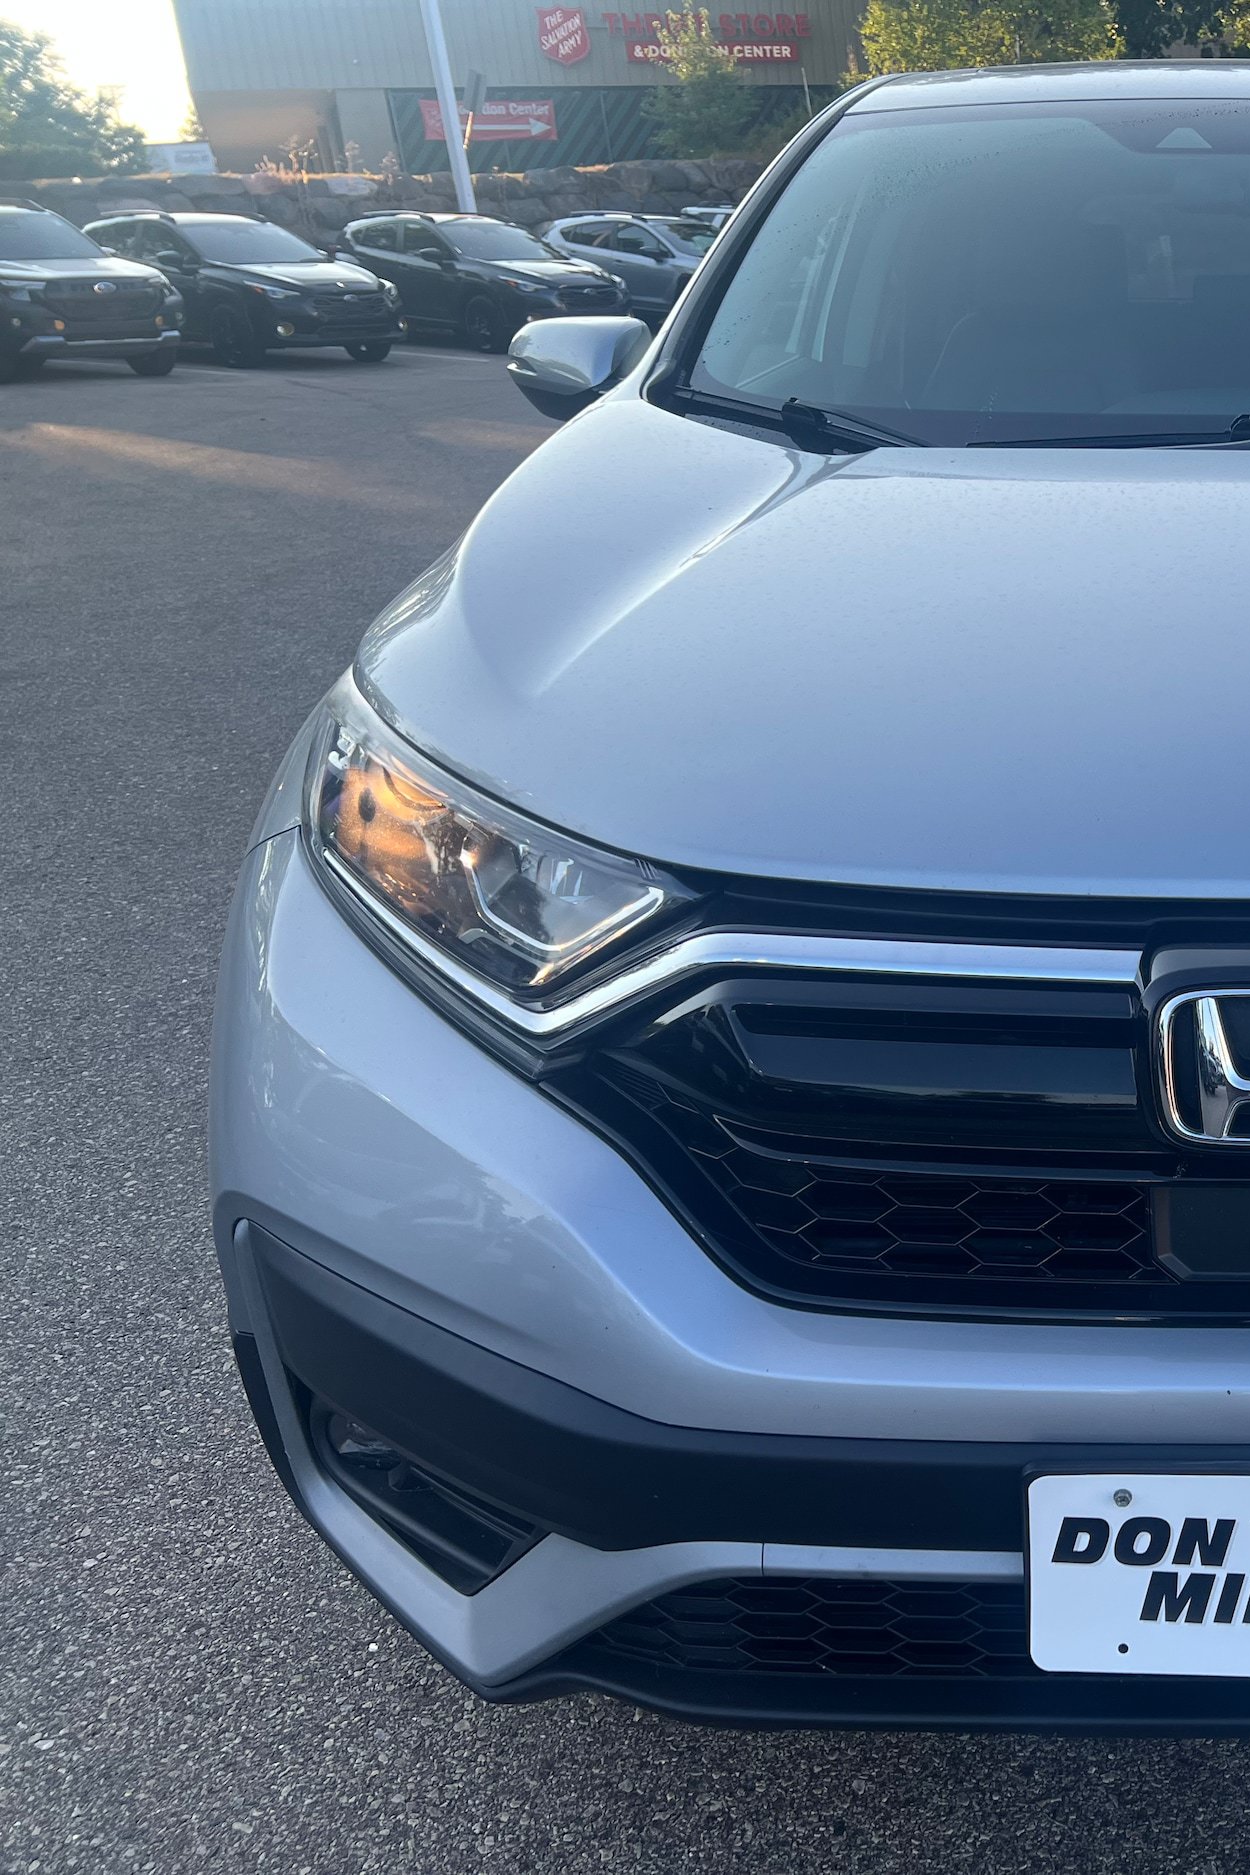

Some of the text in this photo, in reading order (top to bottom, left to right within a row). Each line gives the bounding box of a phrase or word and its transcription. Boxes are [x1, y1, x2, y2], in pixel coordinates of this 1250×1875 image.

[541, 12, 581, 50] SALVATION
[544, 10, 563, 30] THE
[719, 12, 811, 37] STORE
[558, 30, 581, 58] ARMY
[633, 44, 645, 58] &
[733, 45, 792, 58] CENTER
[509, 102, 550, 115] Center
[1051, 1516, 1236, 1567] DON
